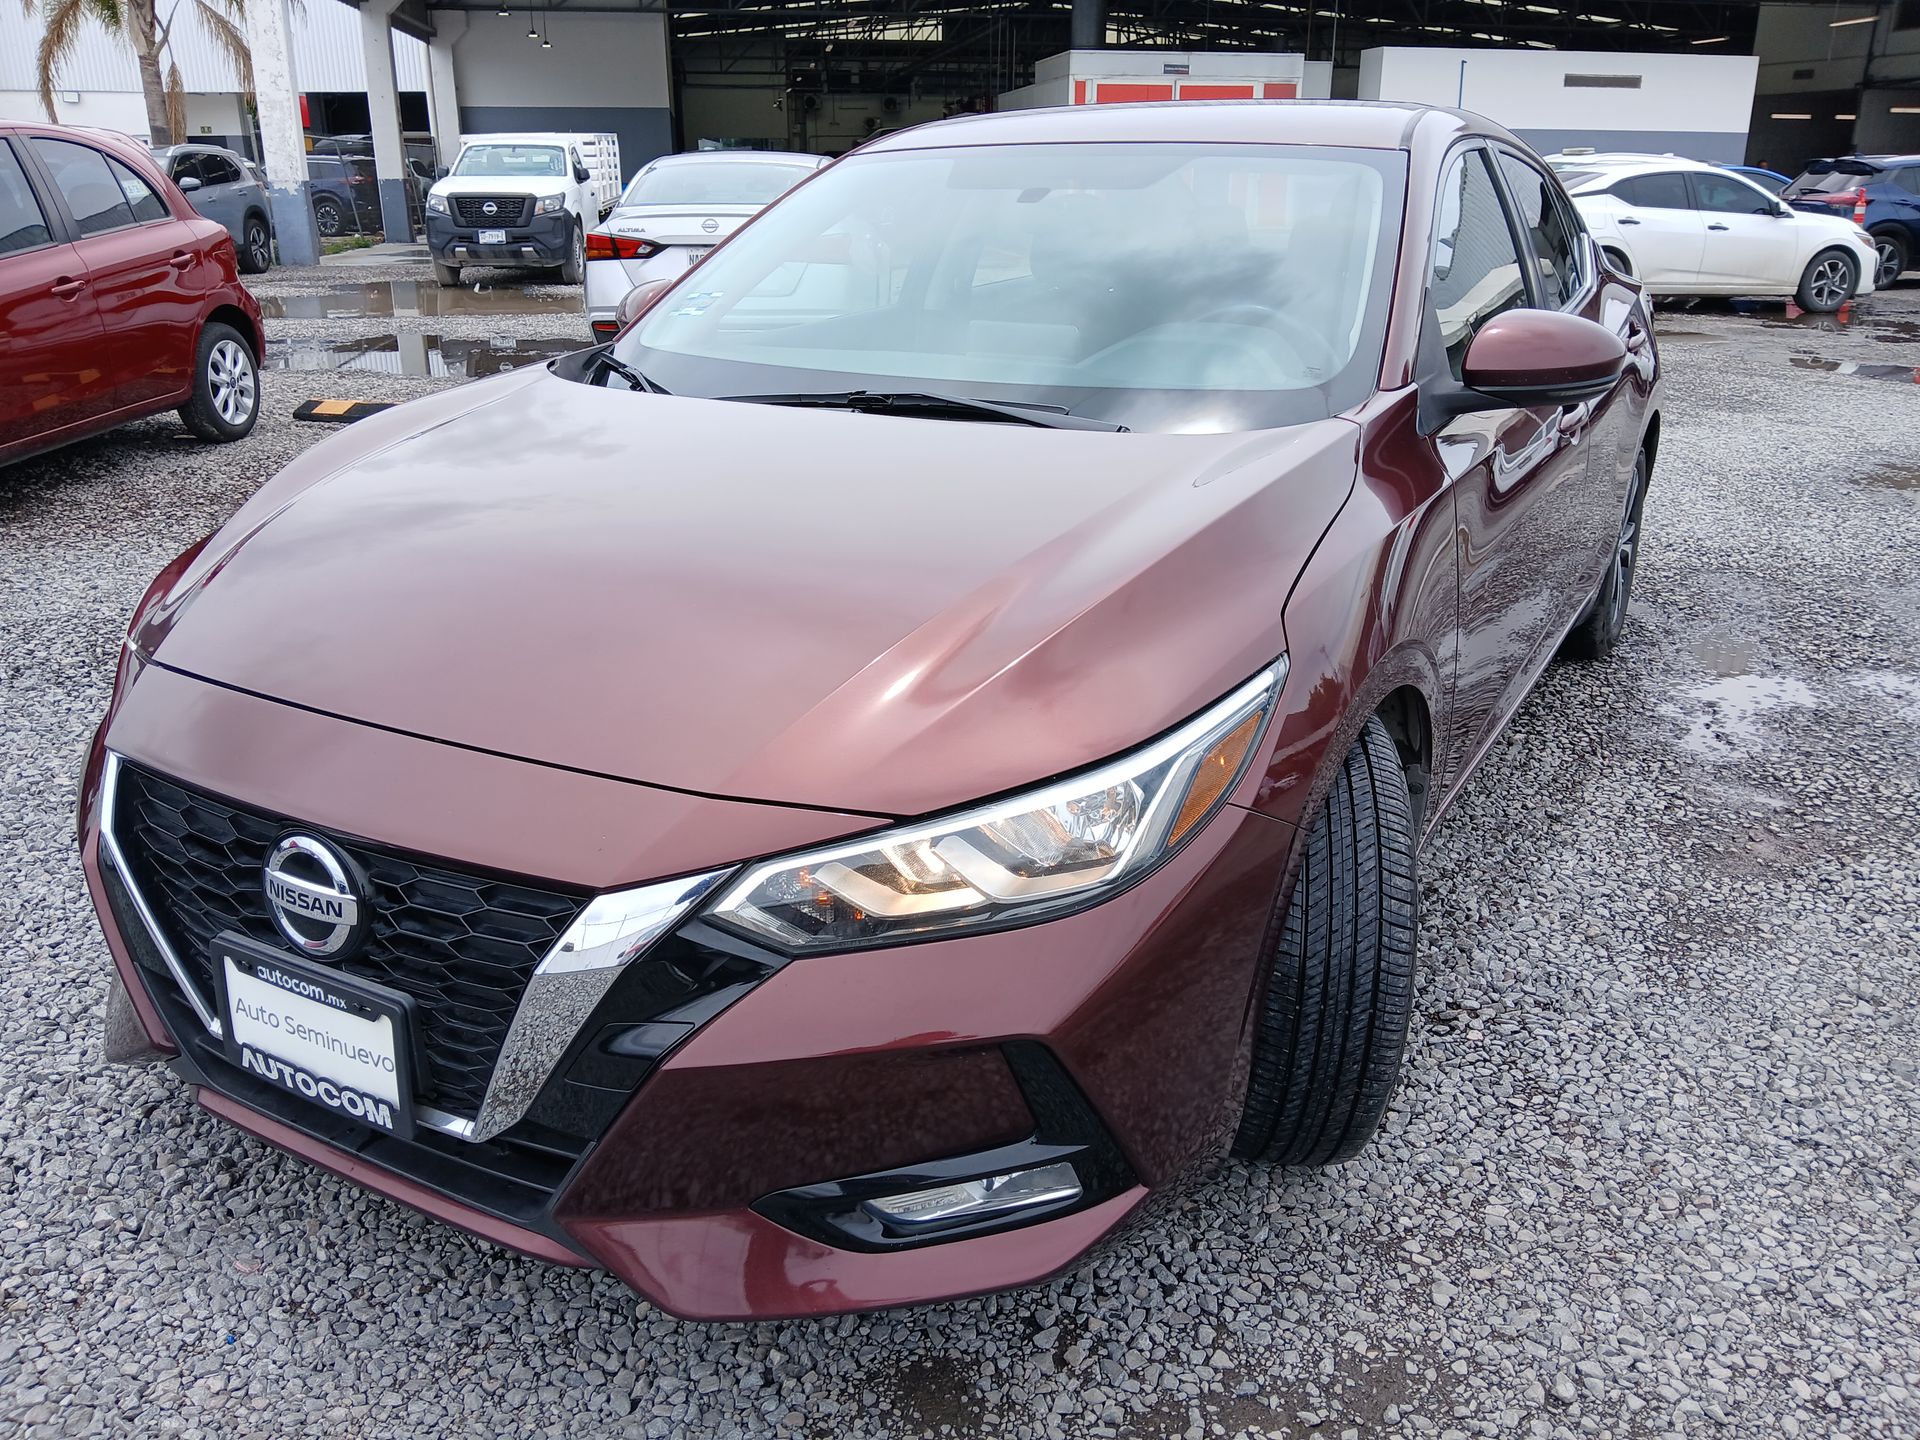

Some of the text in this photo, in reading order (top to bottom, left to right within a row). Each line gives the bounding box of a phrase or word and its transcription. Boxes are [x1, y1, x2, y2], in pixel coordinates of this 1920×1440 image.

[269, 879, 343, 918] NISSAN
[257, 965, 347, 1010] autocom.mx
[235, 997, 395, 1073] Auto Seminuevo
[241, 1047, 394, 1130] AUTOCOM
